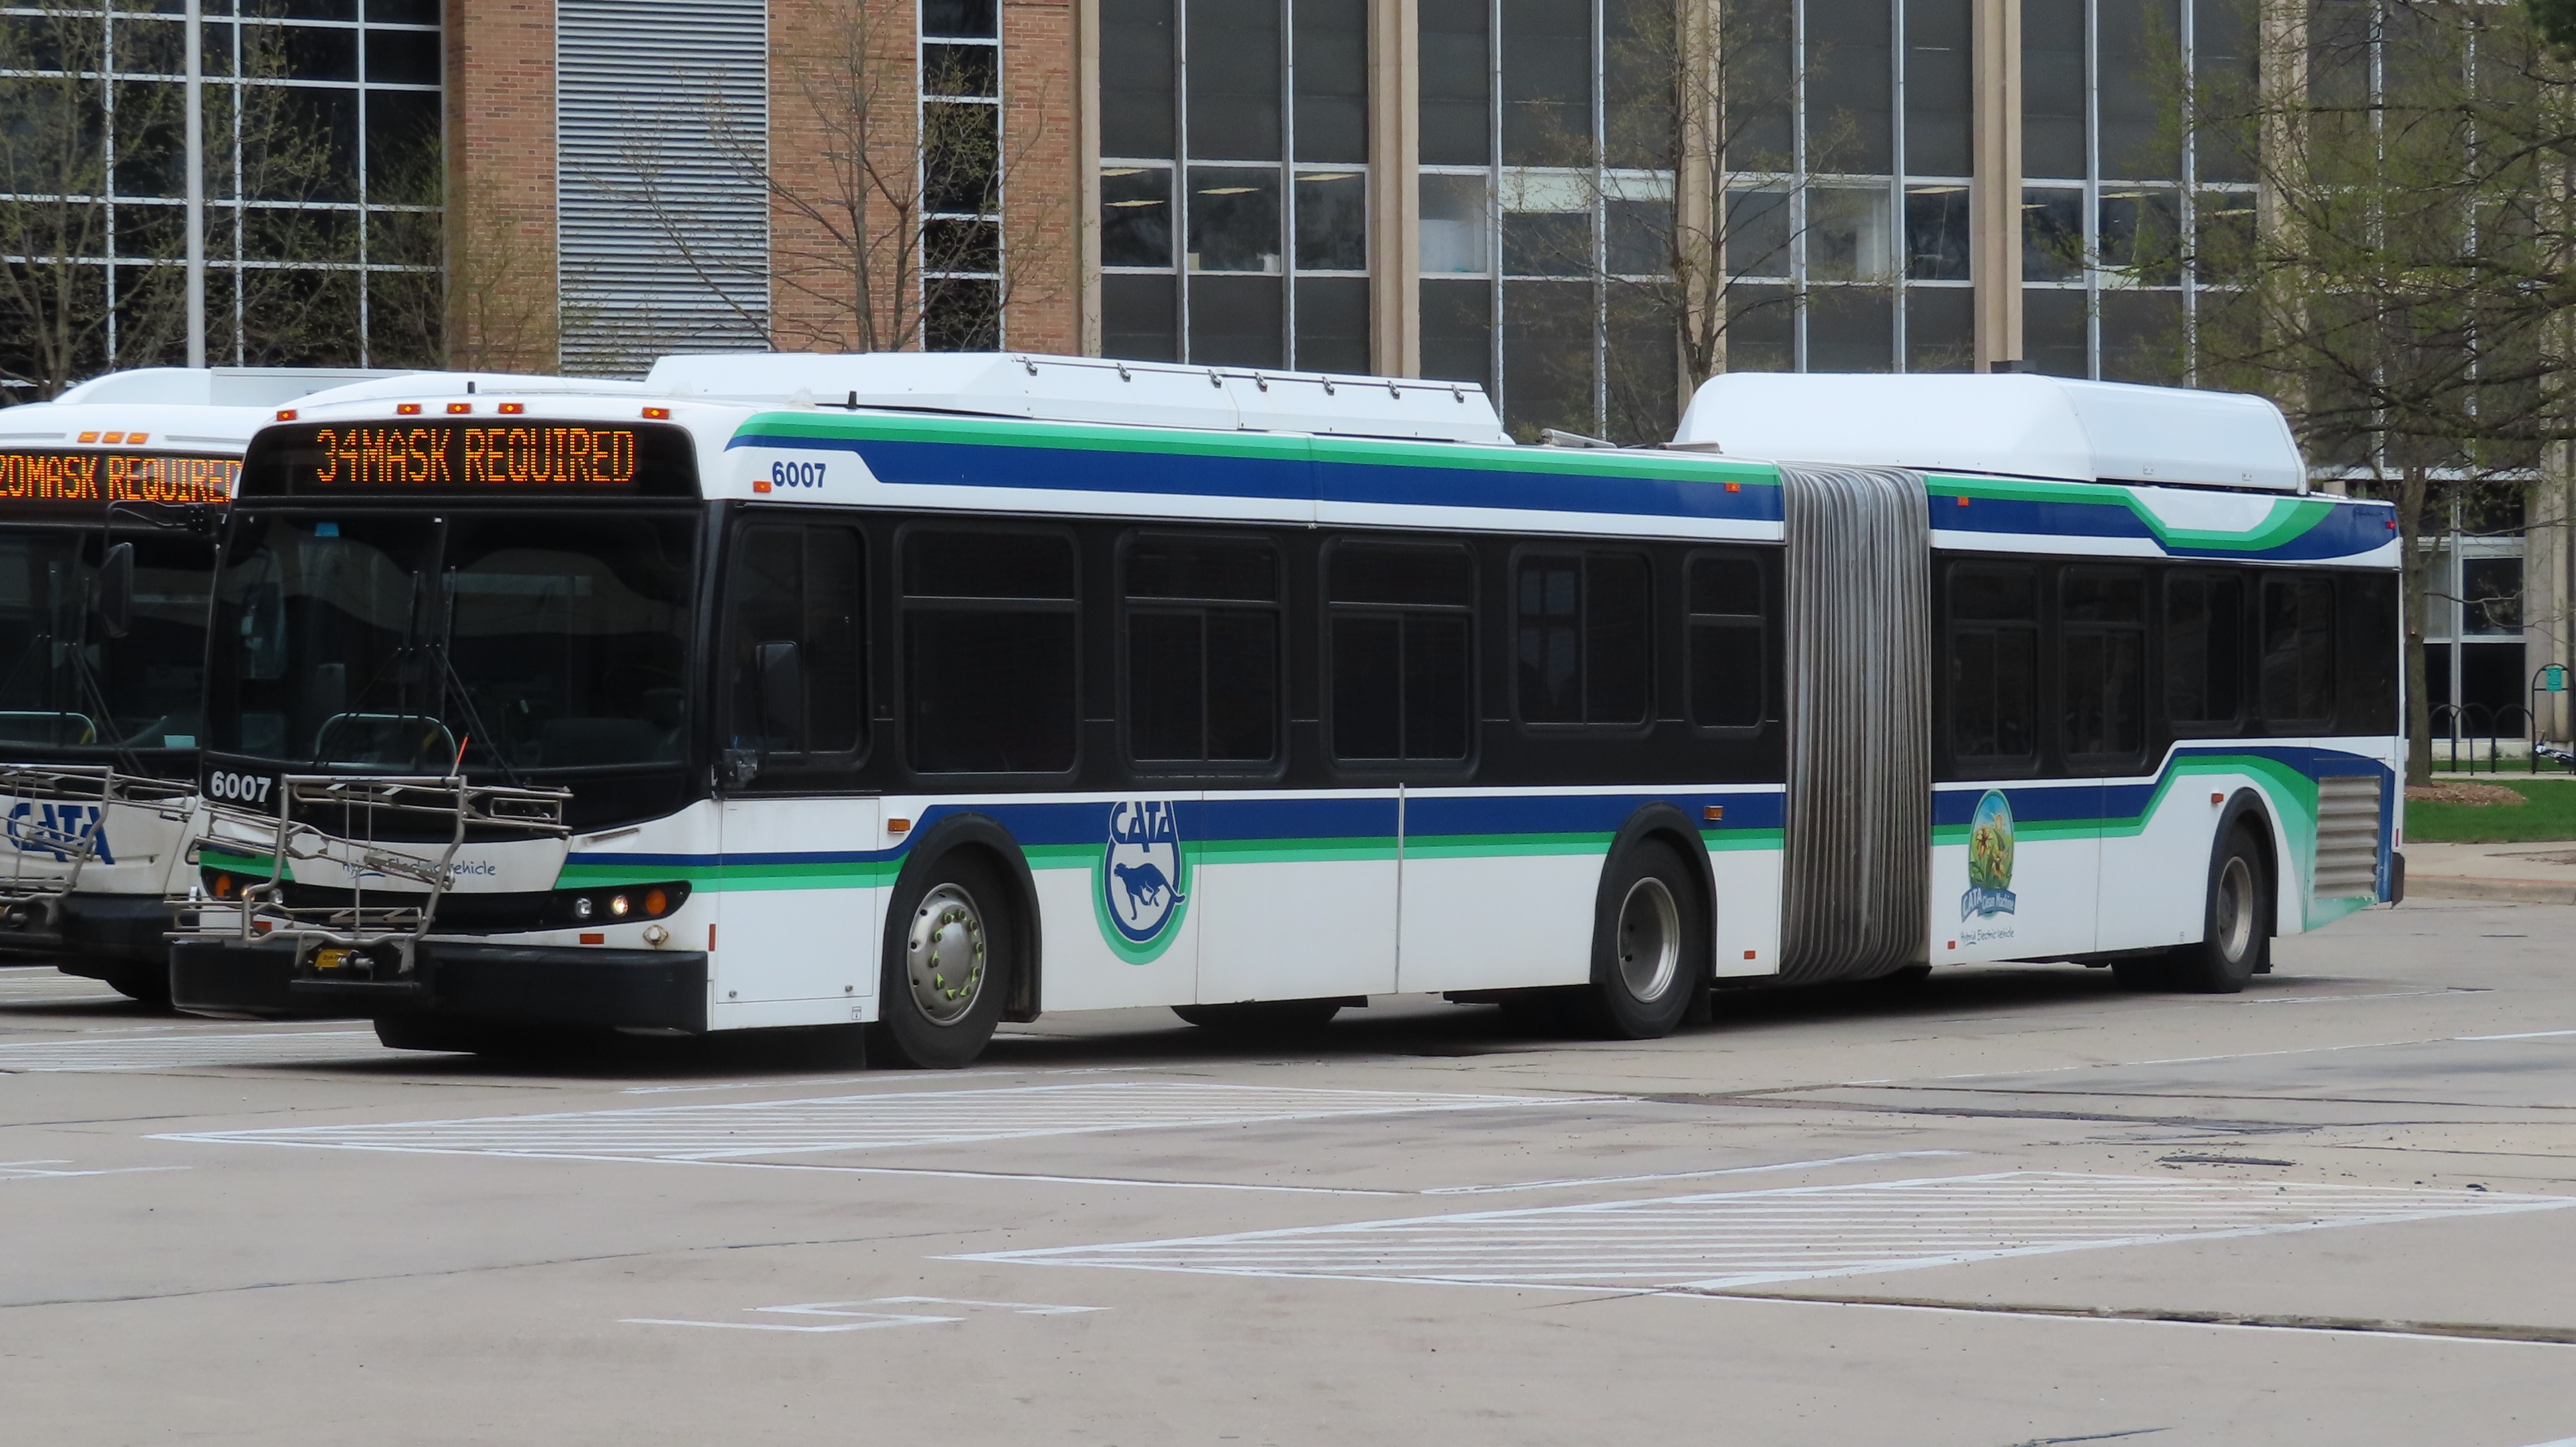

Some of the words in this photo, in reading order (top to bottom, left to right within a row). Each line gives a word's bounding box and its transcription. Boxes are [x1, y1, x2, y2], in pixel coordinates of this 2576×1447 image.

[464, 428, 634, 482] REQUIRED
[772, 462, 826, 487] 6007
[211, 771, 271, 802] 6007
[7, 802, 116, 865] CATA
[1111, 801, 1178, 853] CATA
[1962, 887, 1982, 916] CATA
